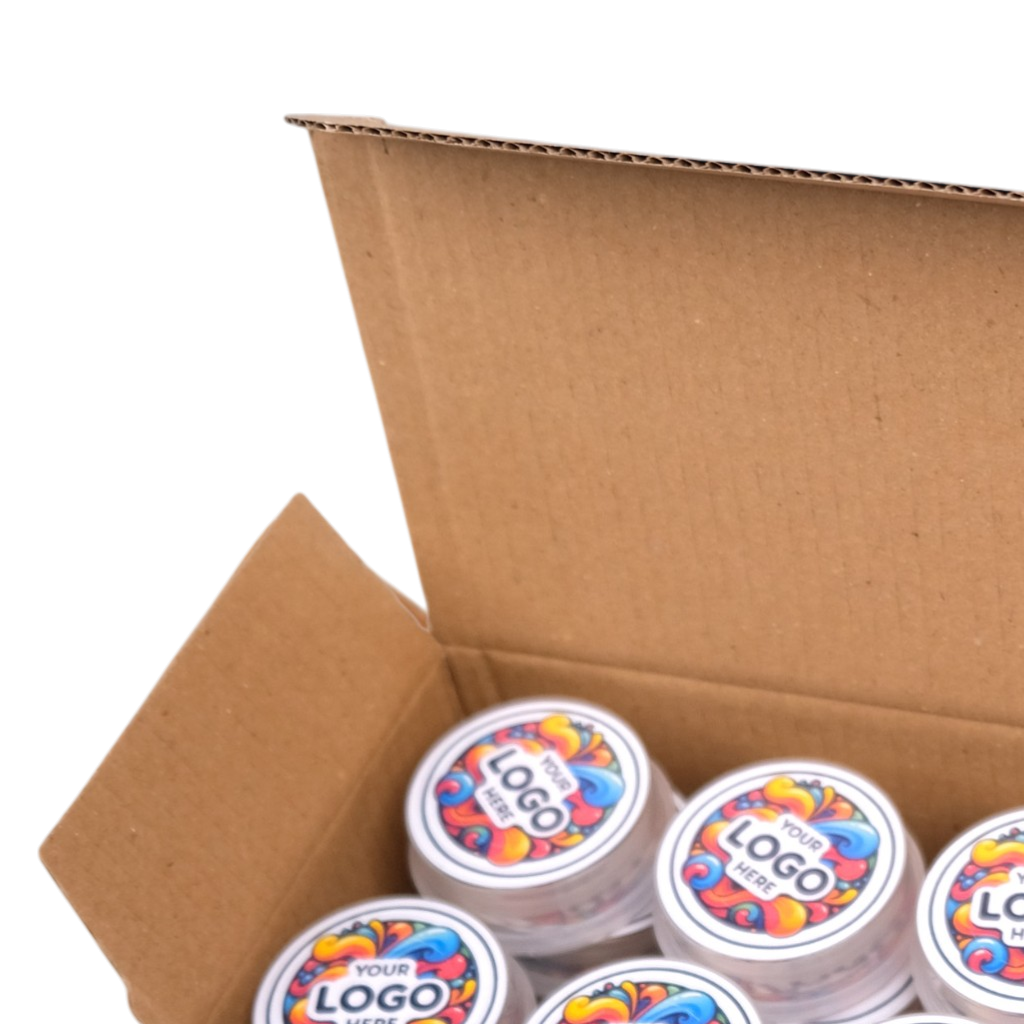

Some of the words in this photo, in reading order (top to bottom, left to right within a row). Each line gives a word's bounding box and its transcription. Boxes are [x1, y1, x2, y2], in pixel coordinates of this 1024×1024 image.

[487, 748, 564, 833] LOGO
[541, 755, 572, 792] YOUR
[482, 787, 515, 822] HERE
[780, 819, 823, 852] YOUR
[725, 819, 829, 896] LOGO
[733, 861, 777, 895] HERE
[355, 963, 410, 977] YOUR
[315, 983, 444, 1014] LOGO
